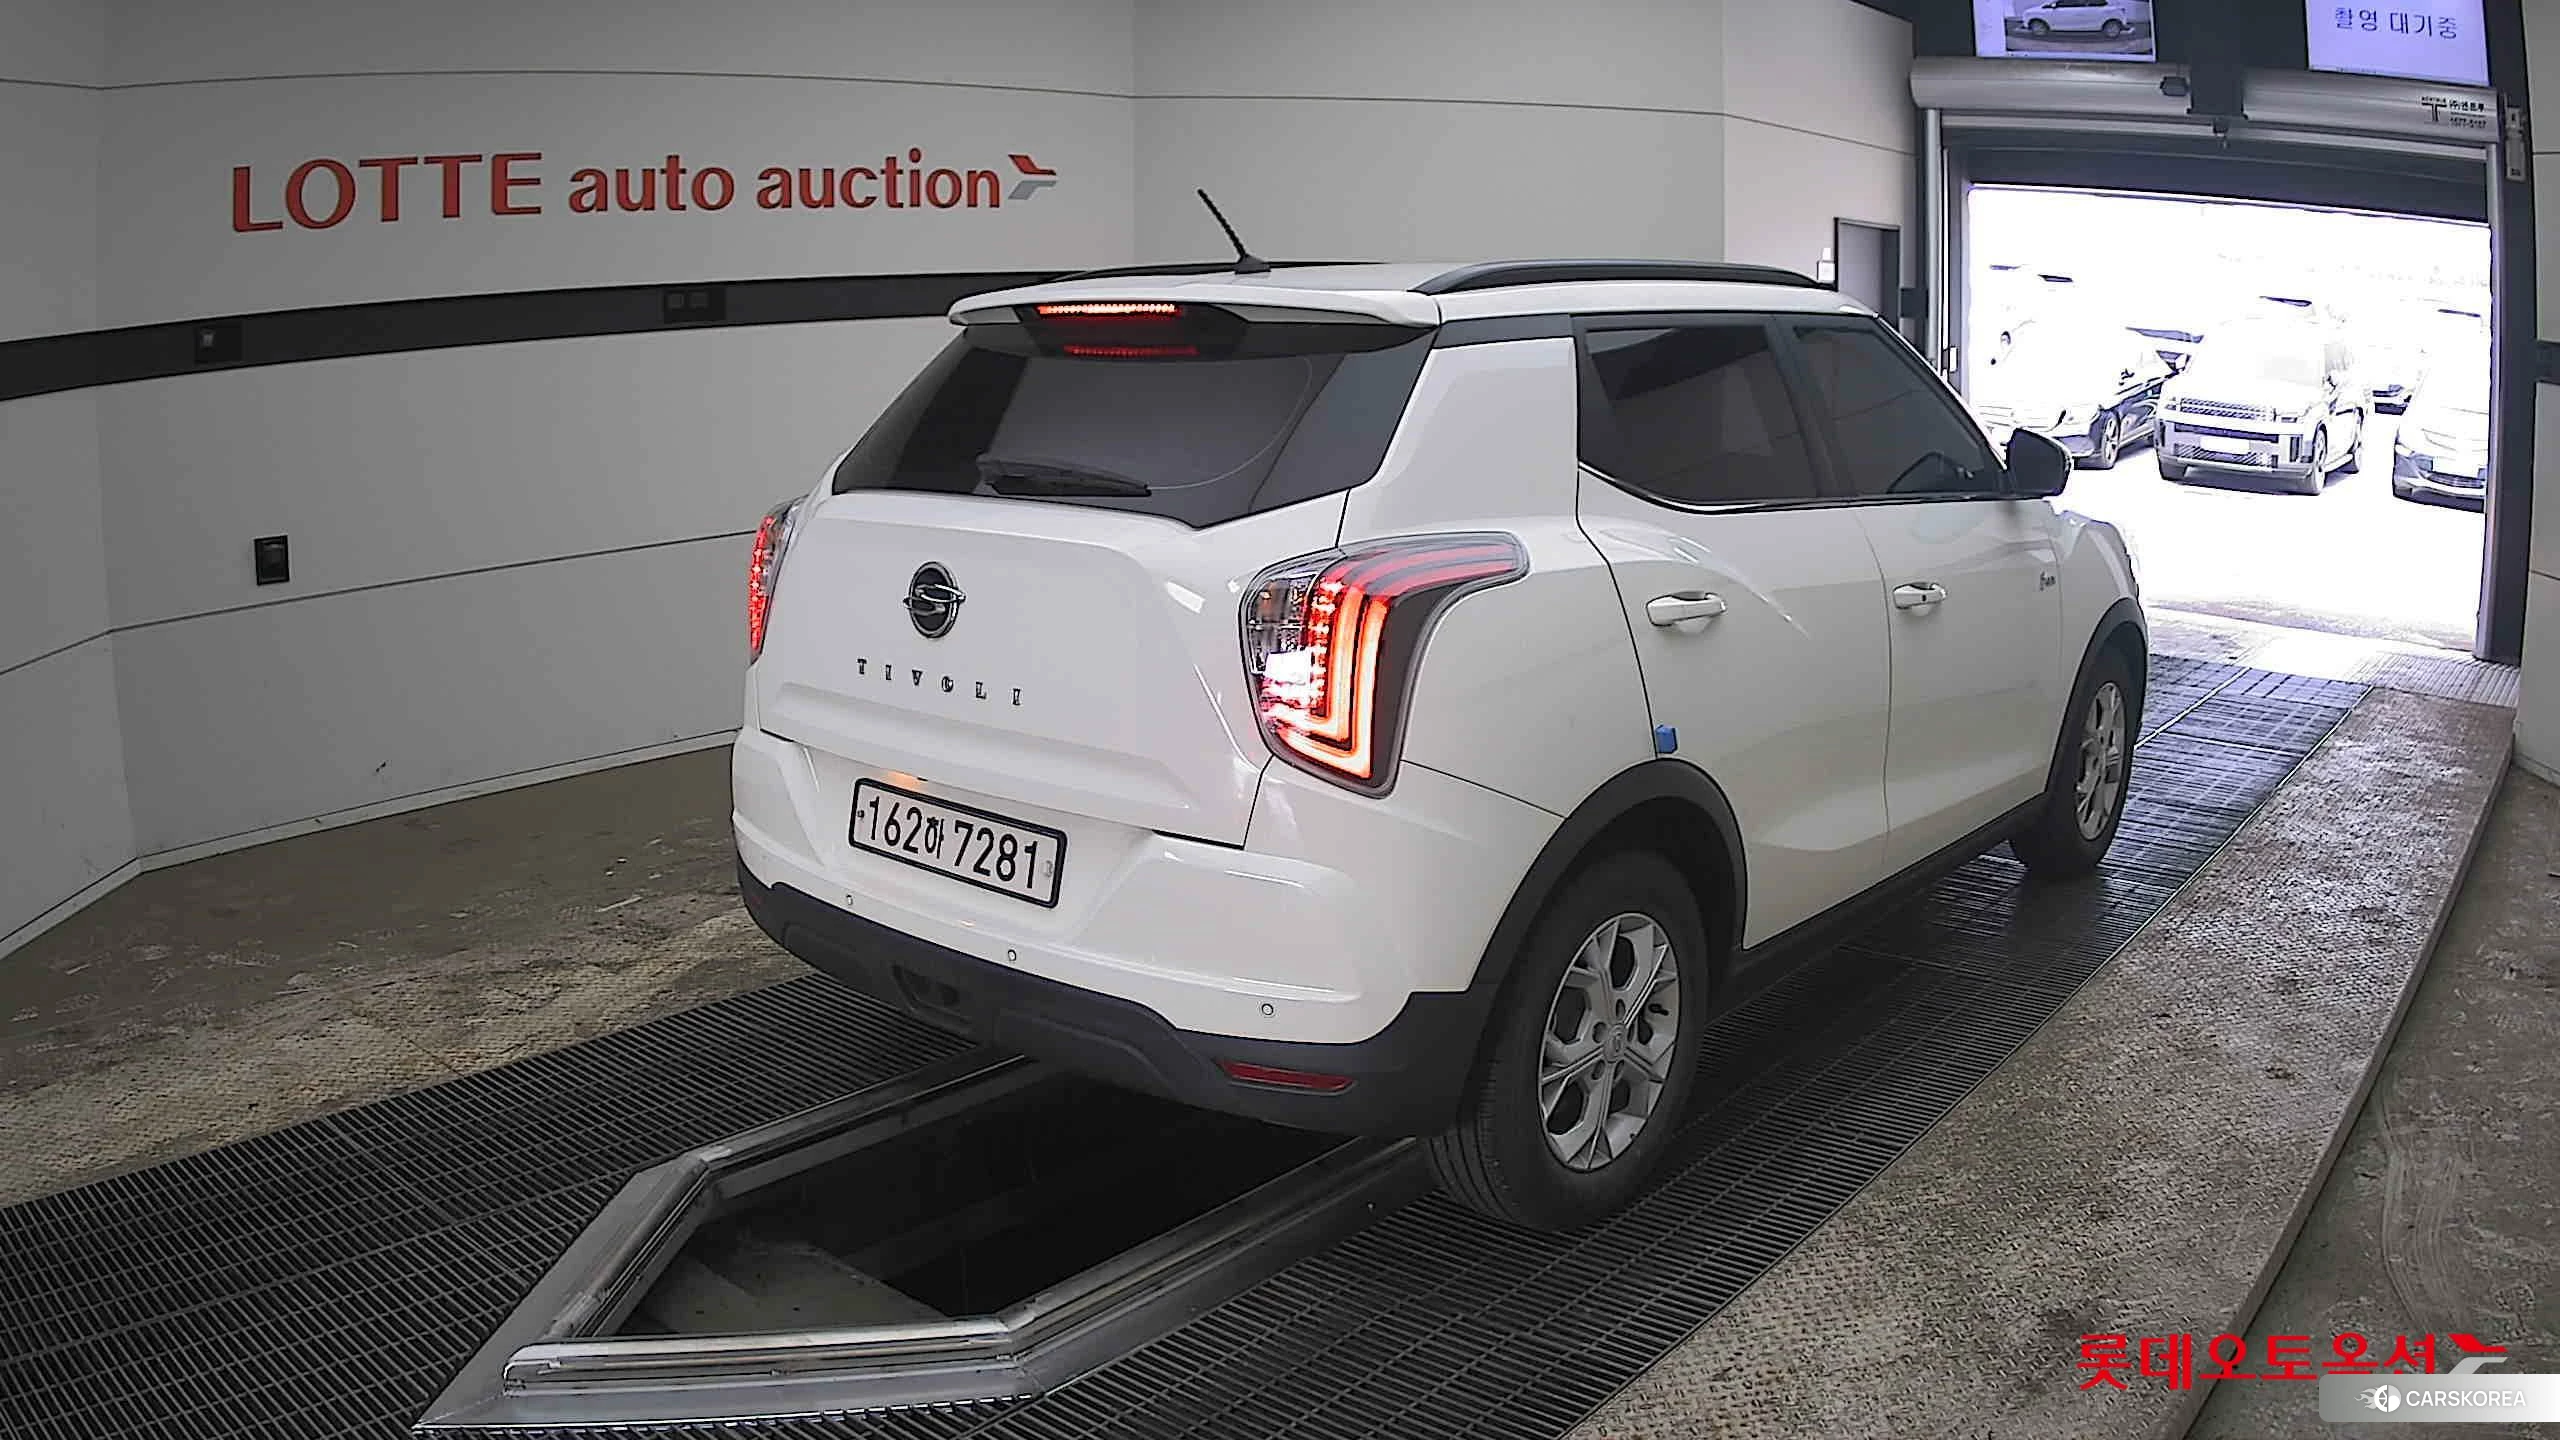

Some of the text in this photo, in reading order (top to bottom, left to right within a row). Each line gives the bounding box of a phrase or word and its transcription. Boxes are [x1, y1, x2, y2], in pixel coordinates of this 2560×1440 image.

[2390, 12, 2457, 40] 대기중
[233, 148, 1001, 233] LOTTE auto auction
[857, 658, 1022, 706] TIVOLI
[869, 796, 1038, 889] 162하 7281
